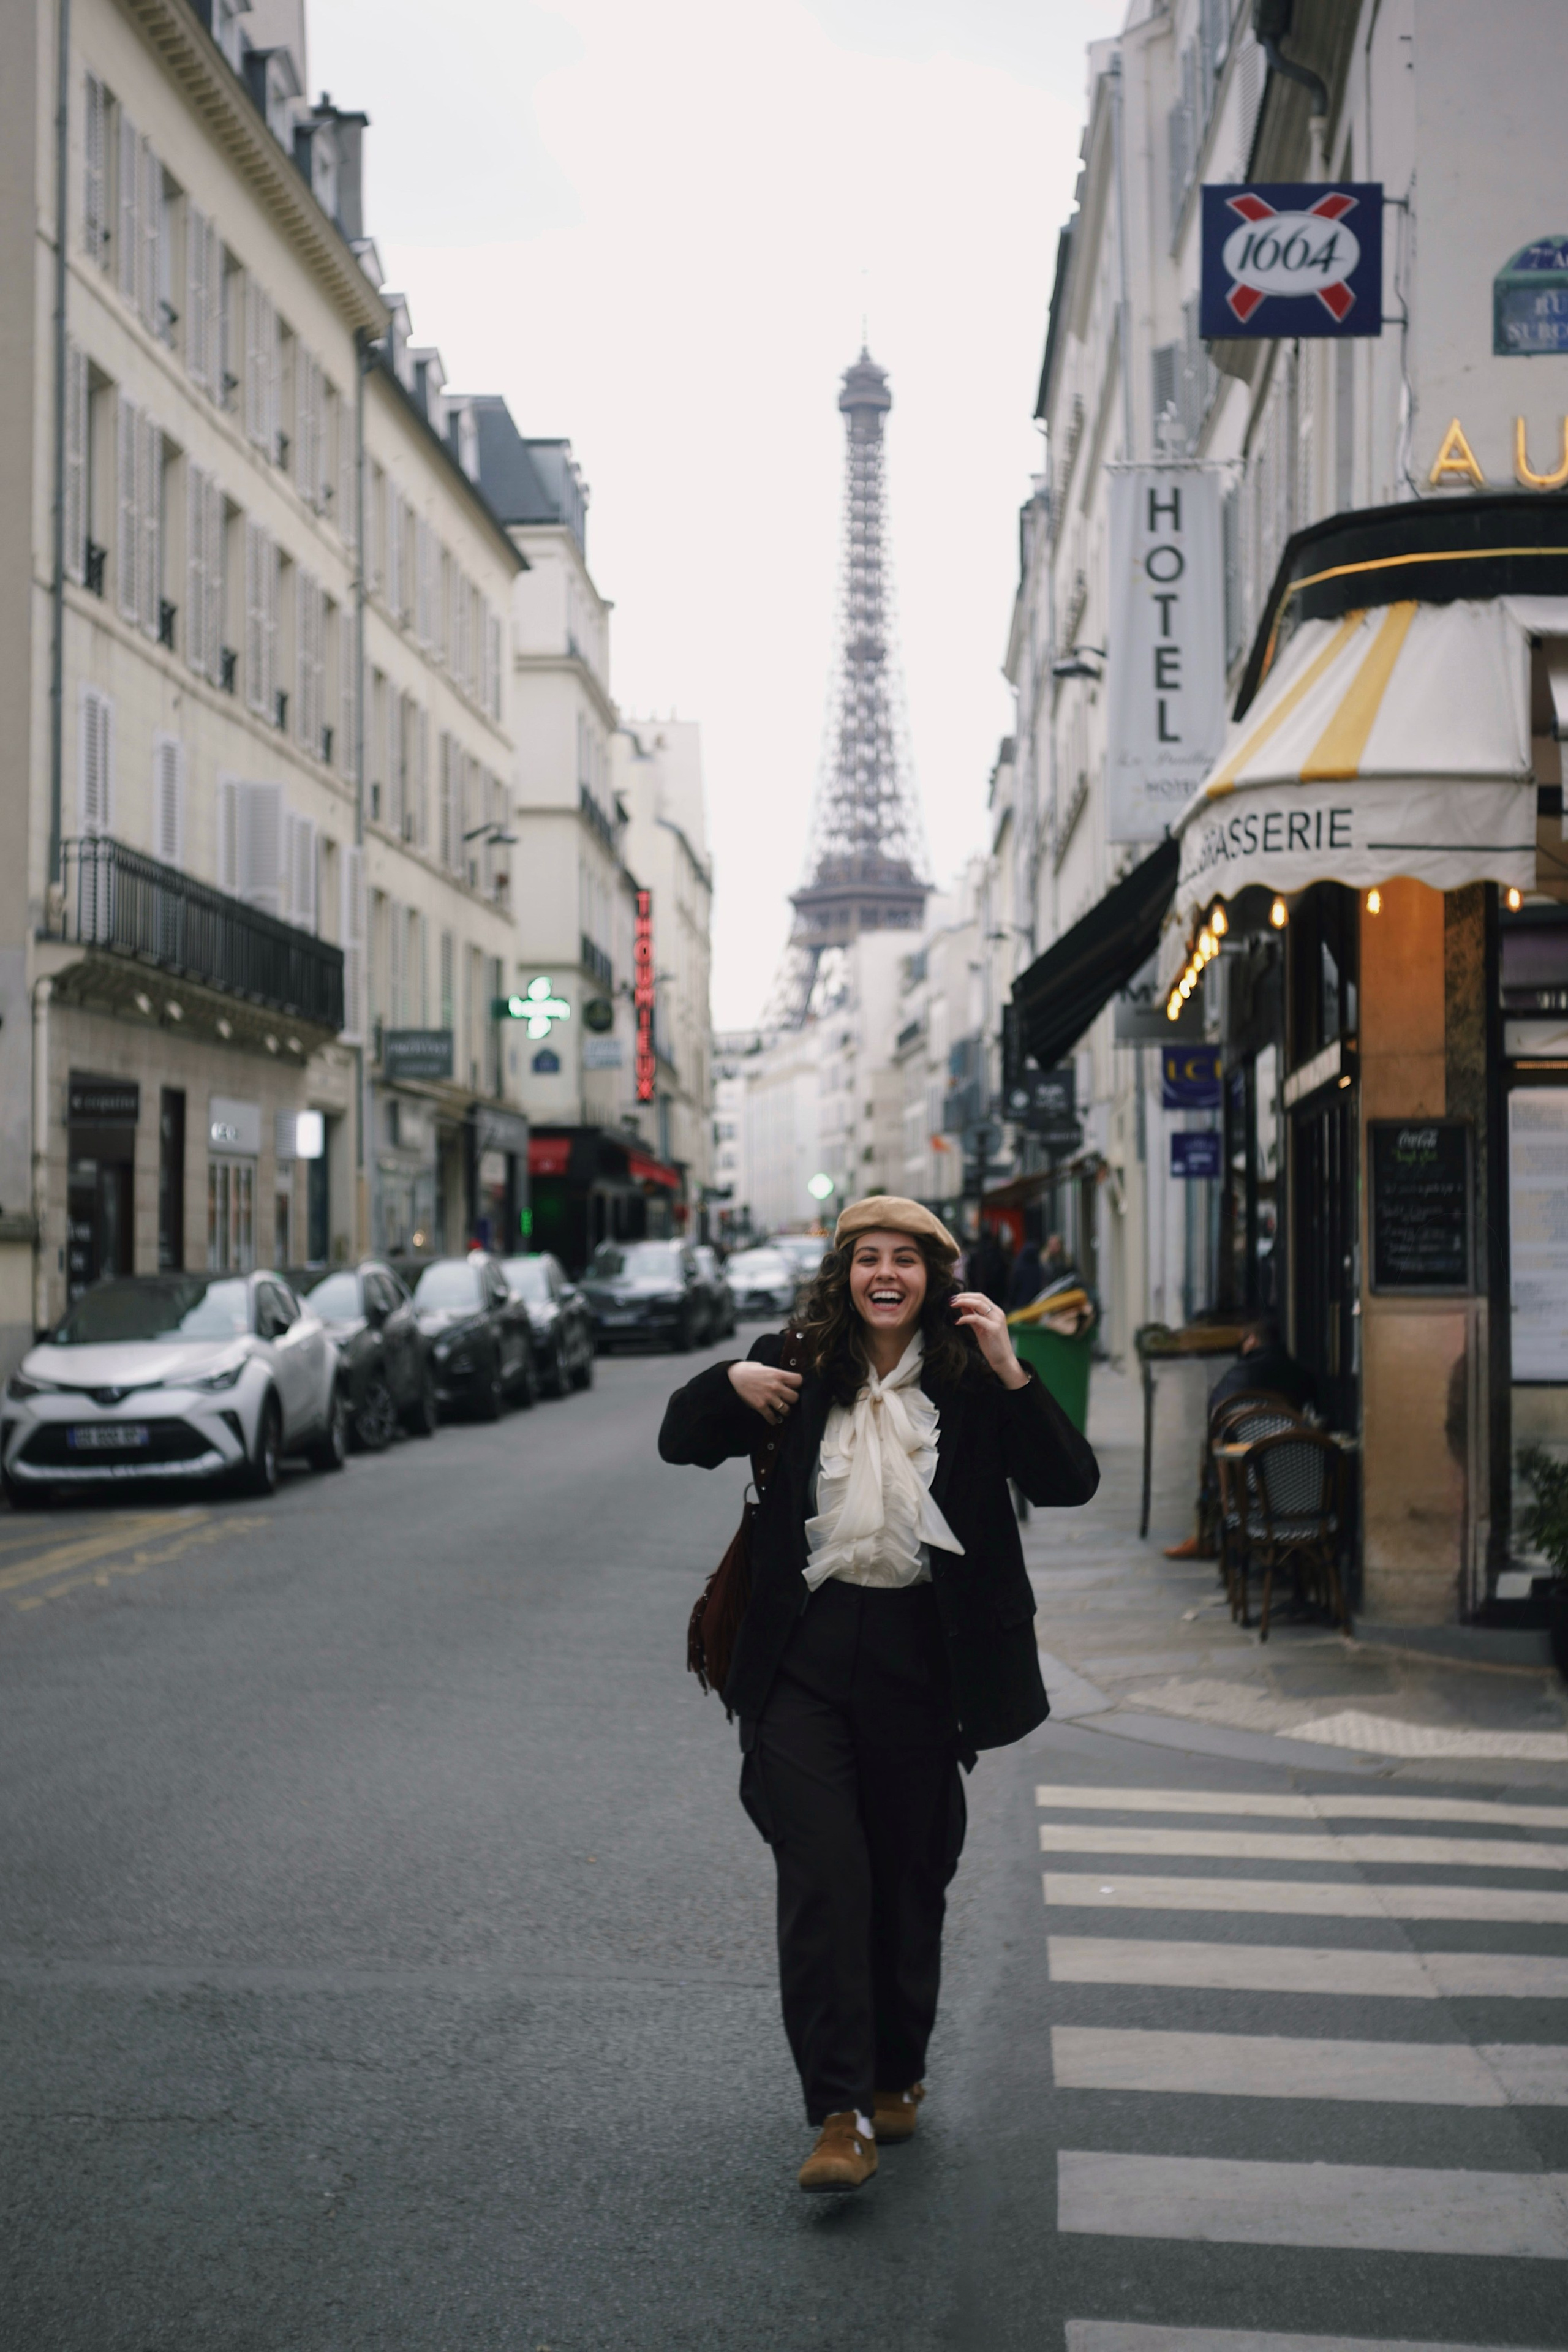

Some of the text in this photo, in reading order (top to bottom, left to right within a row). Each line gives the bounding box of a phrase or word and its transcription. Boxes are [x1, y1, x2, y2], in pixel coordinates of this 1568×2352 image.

[1237, 224, 1345, 274] 1664
[1145, 487, 1185, 742] HOTEL
[634, 890, 655, 1101] THOUMIEUX
